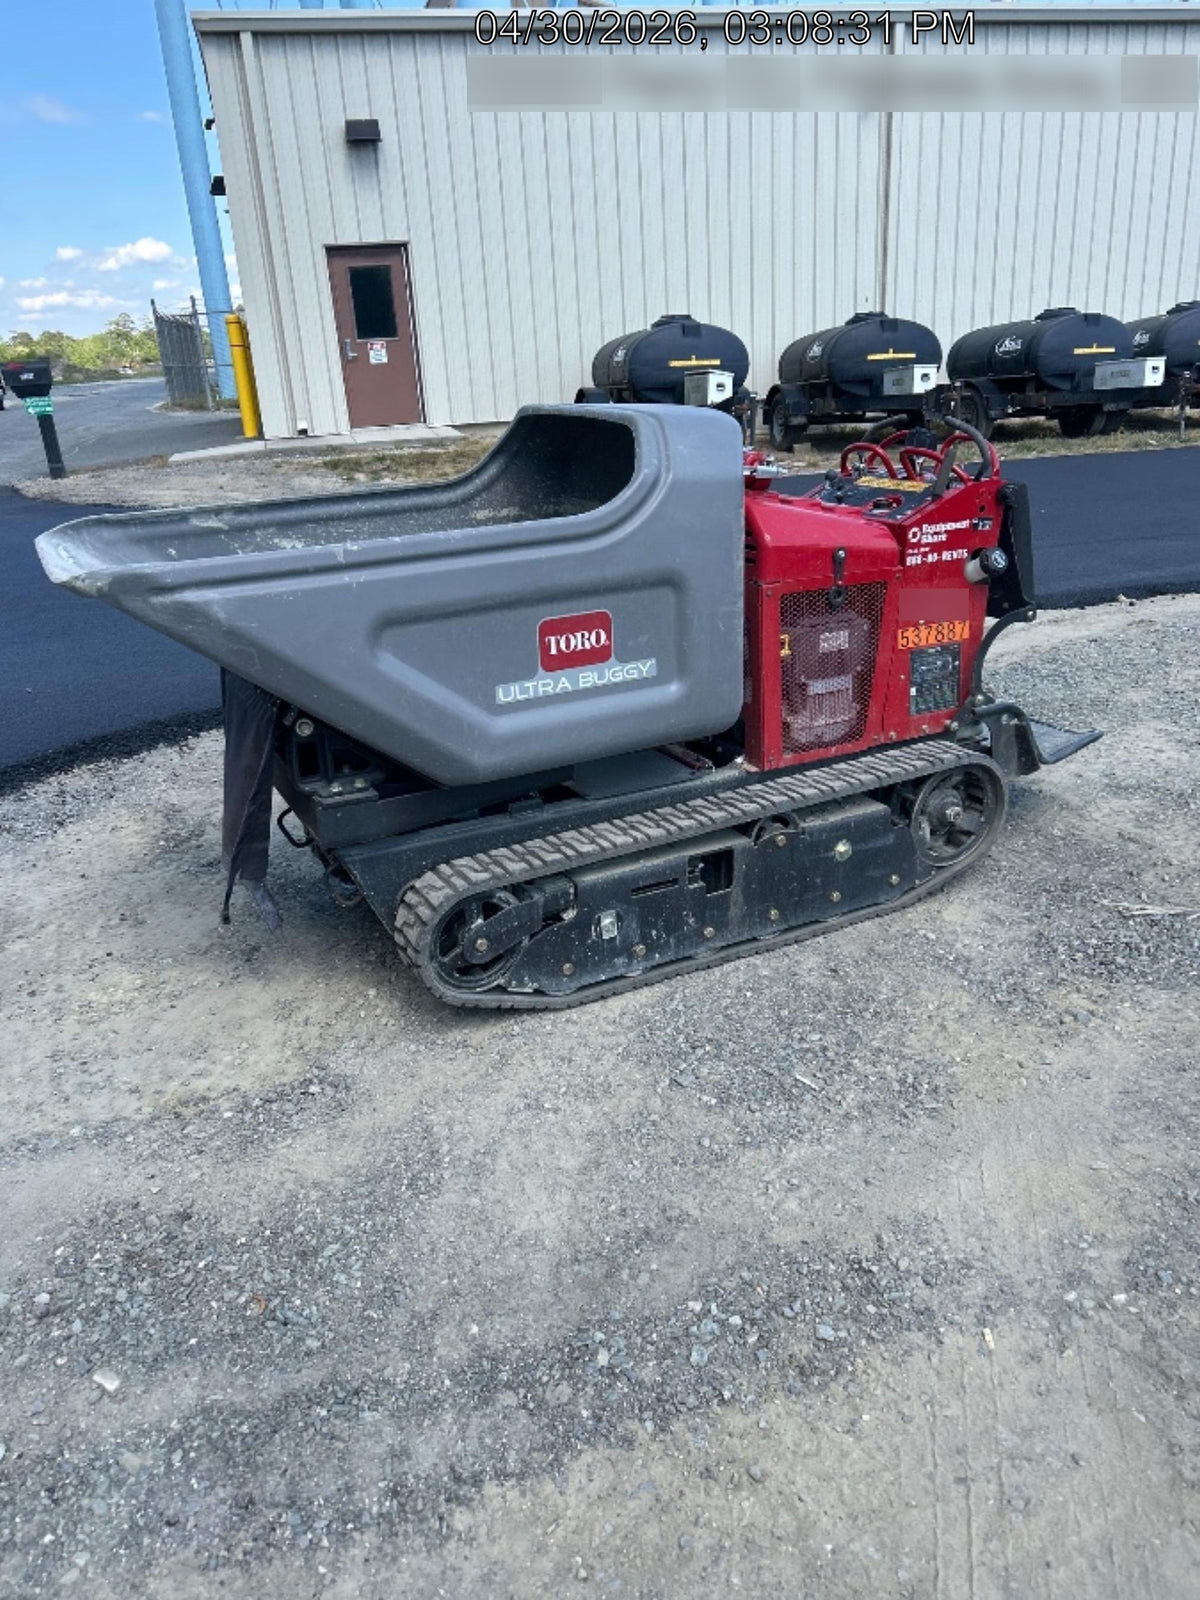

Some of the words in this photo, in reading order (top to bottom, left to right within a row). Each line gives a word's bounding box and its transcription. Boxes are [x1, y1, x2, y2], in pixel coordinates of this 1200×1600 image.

[920, 534, 947, 544] Share
[922, 519, 970, 534] Equipment
[545, 628, 608, 655] TORO
[900, 621, 967, 648] 537887
[498, 676, 572, 702] ULTRA
[579, 660, 652, 688] BUGGY
